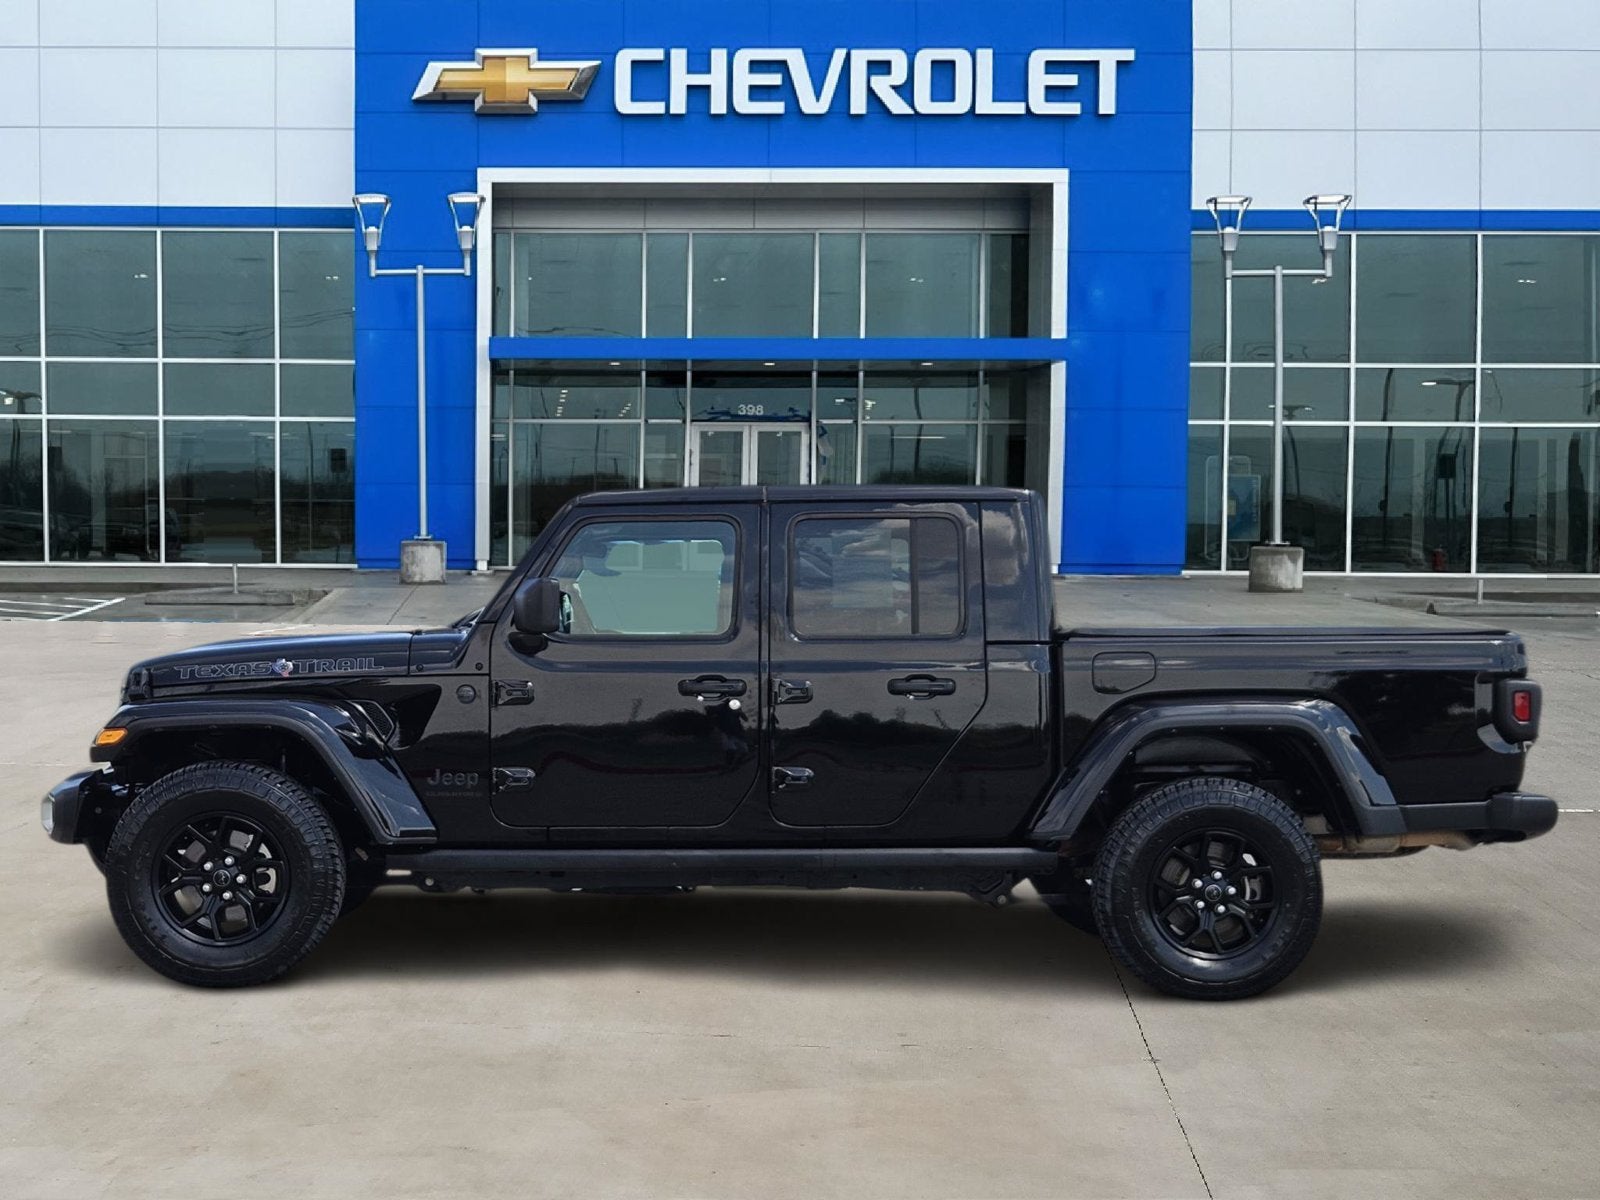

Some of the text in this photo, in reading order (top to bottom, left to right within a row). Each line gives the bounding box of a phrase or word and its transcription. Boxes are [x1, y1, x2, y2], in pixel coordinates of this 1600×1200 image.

[614, 47, 1136, 116] CHEVROLET
[738, 404, 764, 415] 398
[175, 658, 385, 679] TEXAS TRAIL
[427, 768, 479, 789] Jeep
